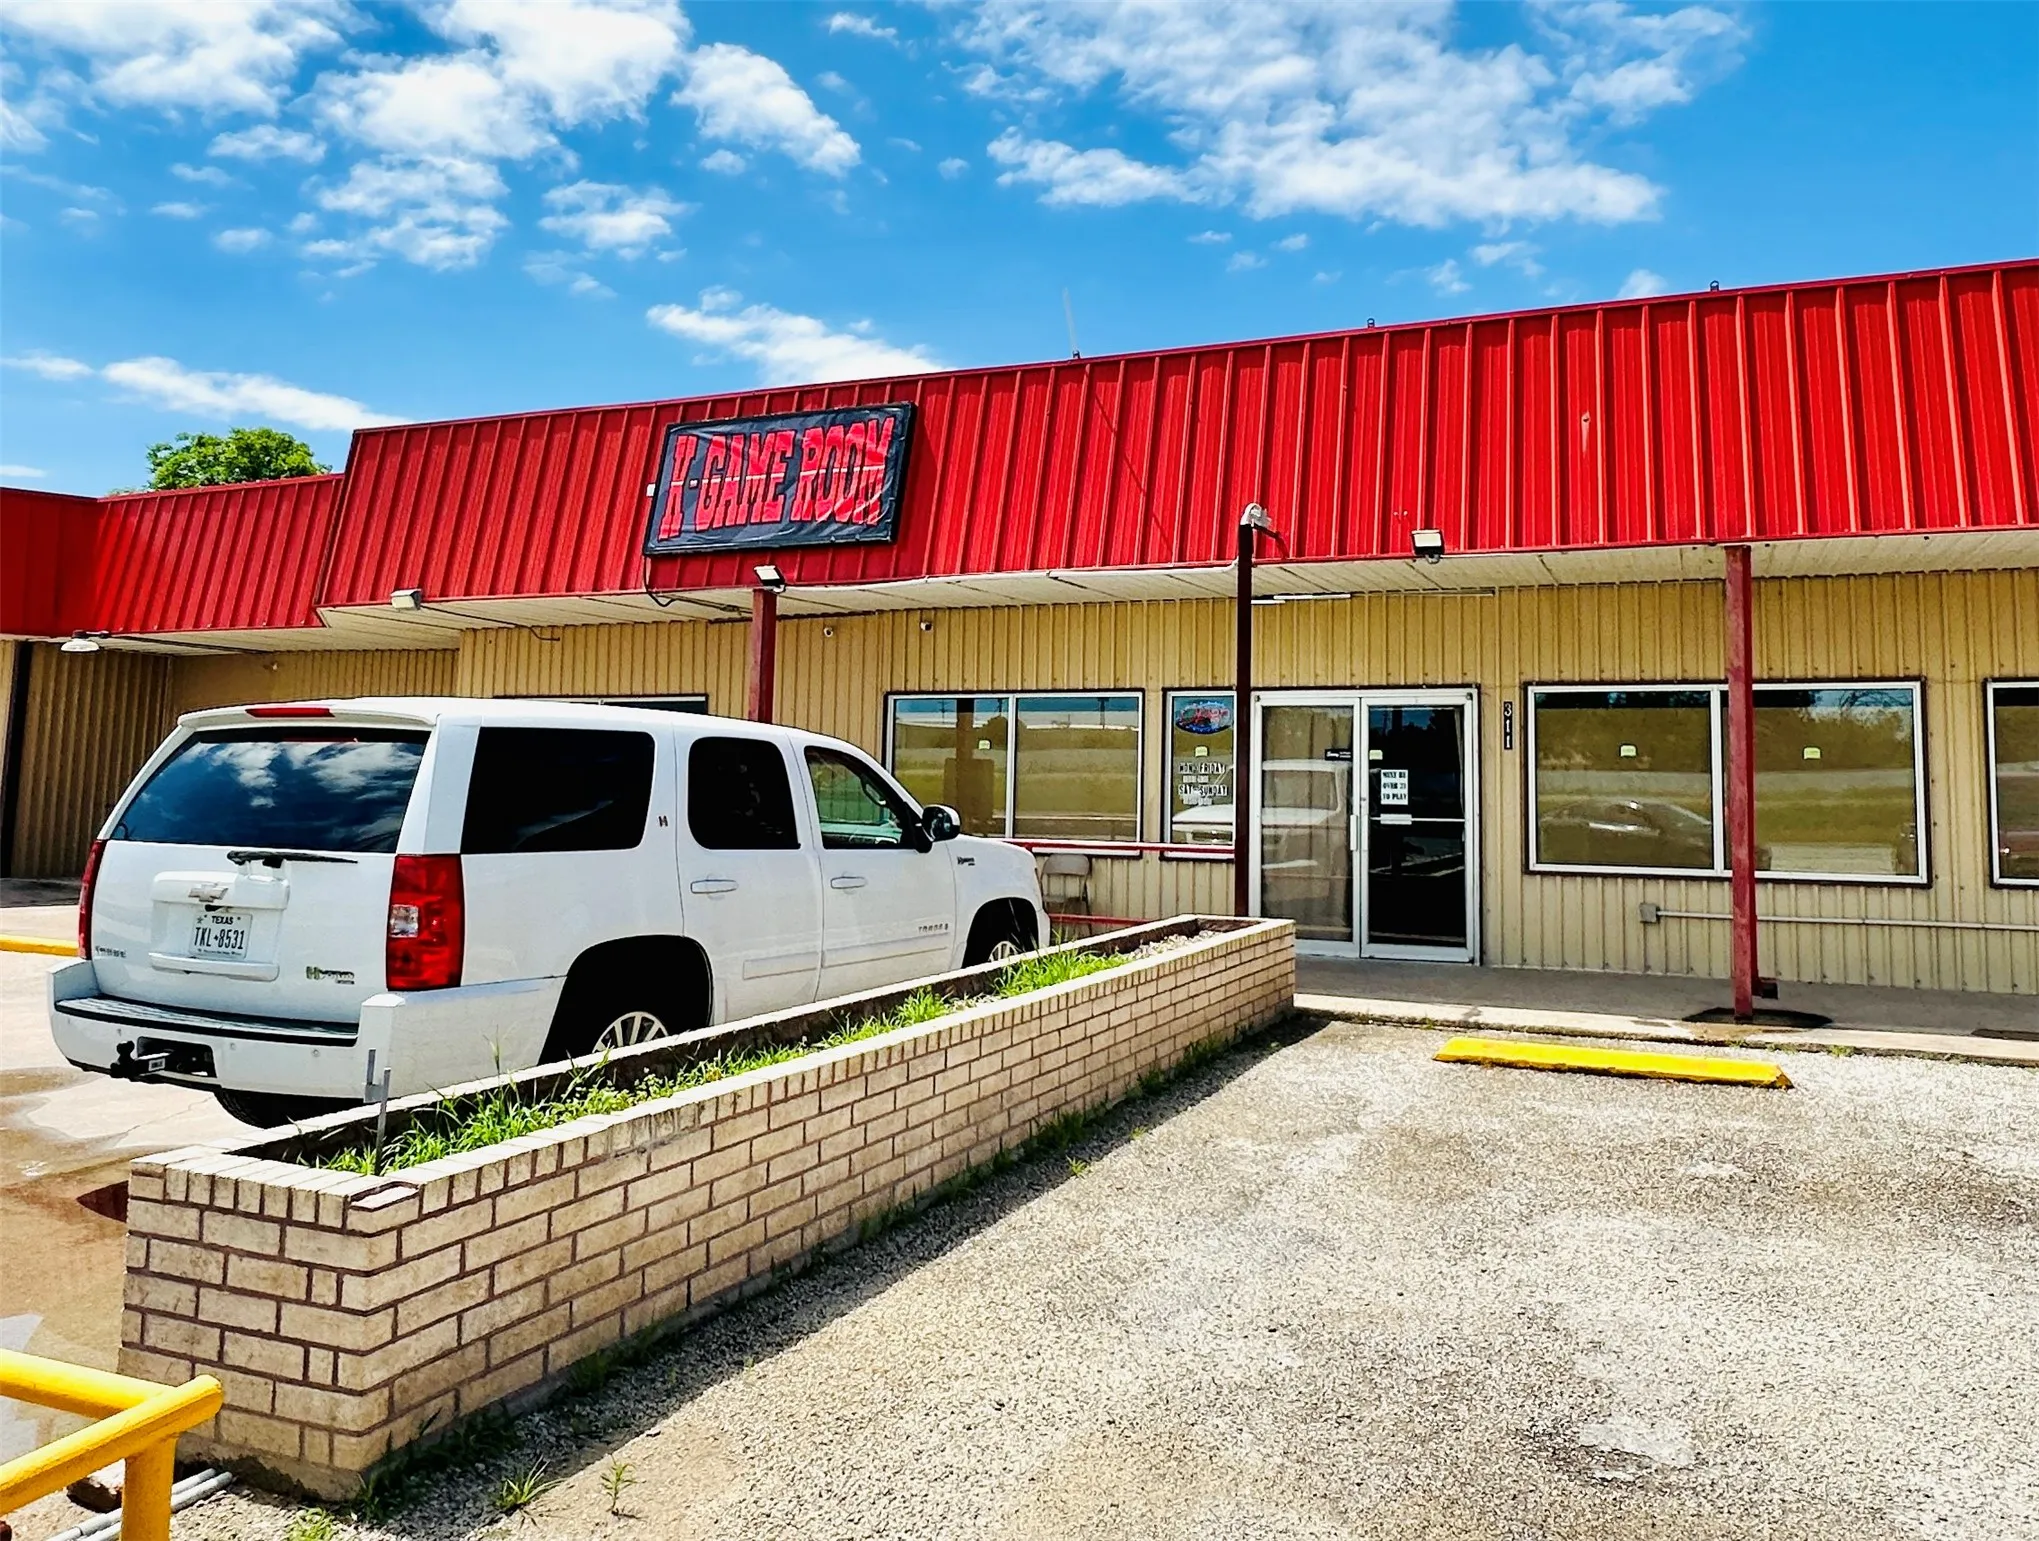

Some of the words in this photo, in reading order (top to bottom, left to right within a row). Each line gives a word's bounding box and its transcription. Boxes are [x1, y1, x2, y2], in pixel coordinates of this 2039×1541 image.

[790, 416, 896, 526] ROOM
[1504, 702, 1512, 748] 311
[1178, 784, 1193, 795] SAT
[1199, 784, 1228, 797] SUNDAY
[211, 915, 234, 925] TEXAS
